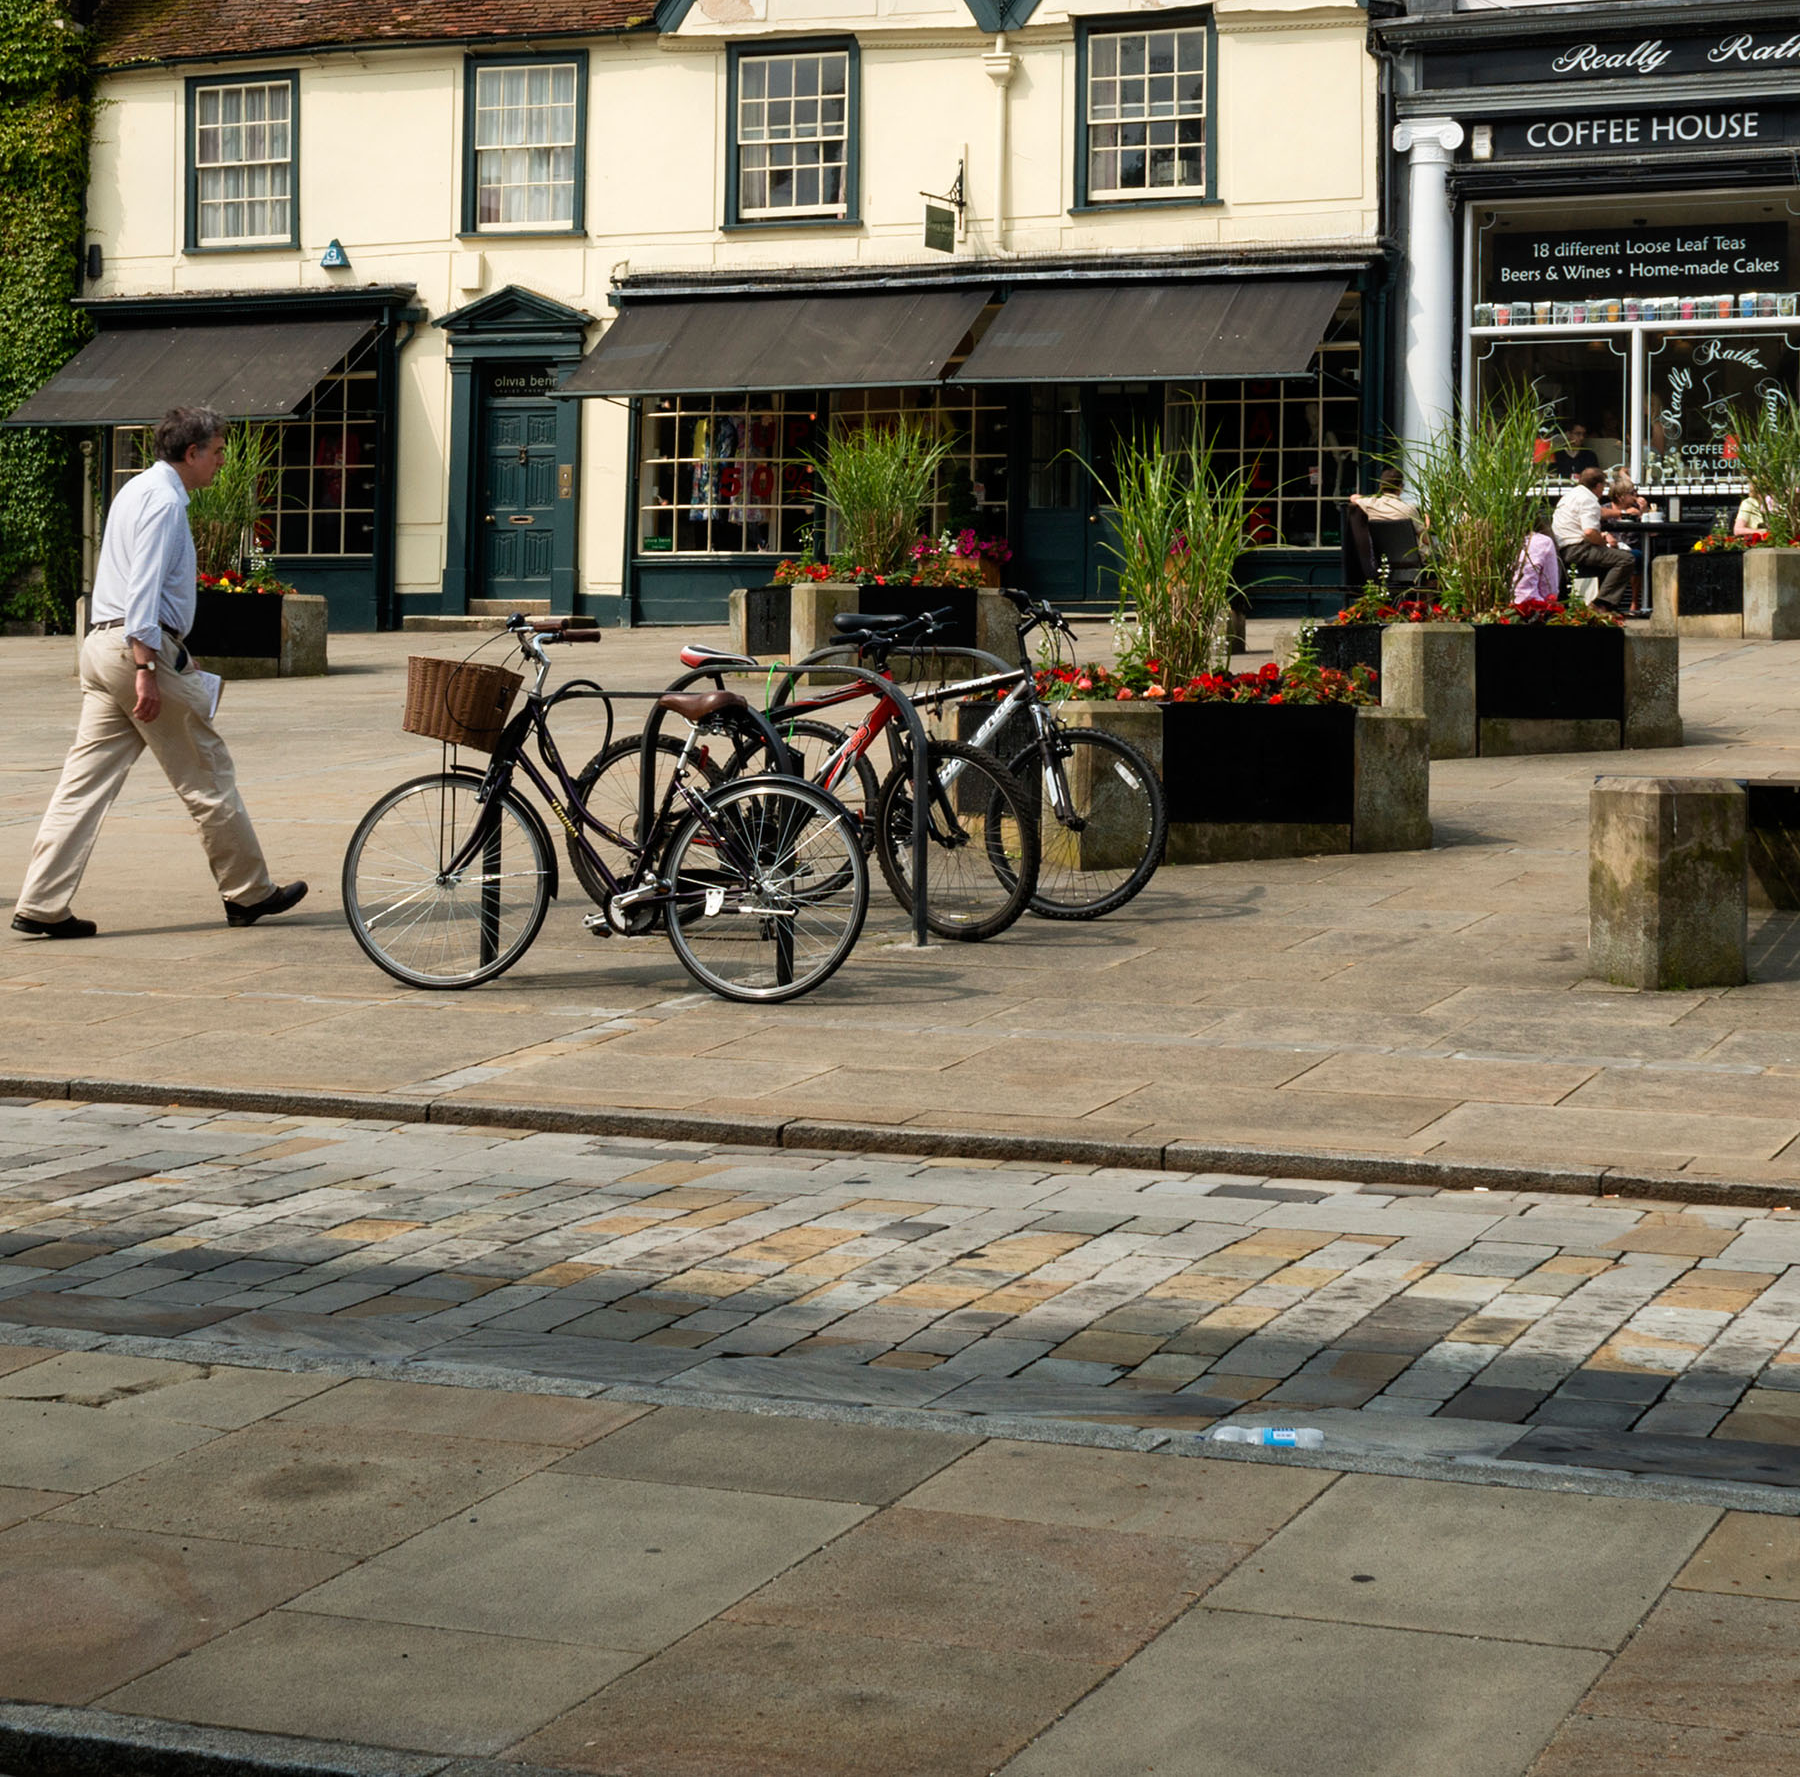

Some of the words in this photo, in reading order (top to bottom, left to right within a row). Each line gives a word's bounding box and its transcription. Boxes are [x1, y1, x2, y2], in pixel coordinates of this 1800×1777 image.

[1551, 40, 1673, 74] Really
[1526, 118, 1640, 148] COFFEE
[1651, 112, 1759, 142] HOUSE
[1532, 243, 1550, 258] 18
[1554, 240, 1621, 257] different
[1626, 238, 1671, 254] Loose
[1676, 236, 1710, 252] Leaf
[1712, 235, 1746, 251] Teas
[1501, 267, 1541, 282] Beers
[1545, 265, 1559, 281] &
[1562, 264, 1611, 280] Wines
[1629, 259, 1729, 278] Home-made
[1733, 257, 1780, 274] Cakes
[494, 375, 526, 387] olivia
[1657, 366, 1693, 440] Really
[1692, 337, 1768, 371] Rather
[1681, 444, 1724, 455] COFFEE
[1687, 459, 1710, 470] TEA
